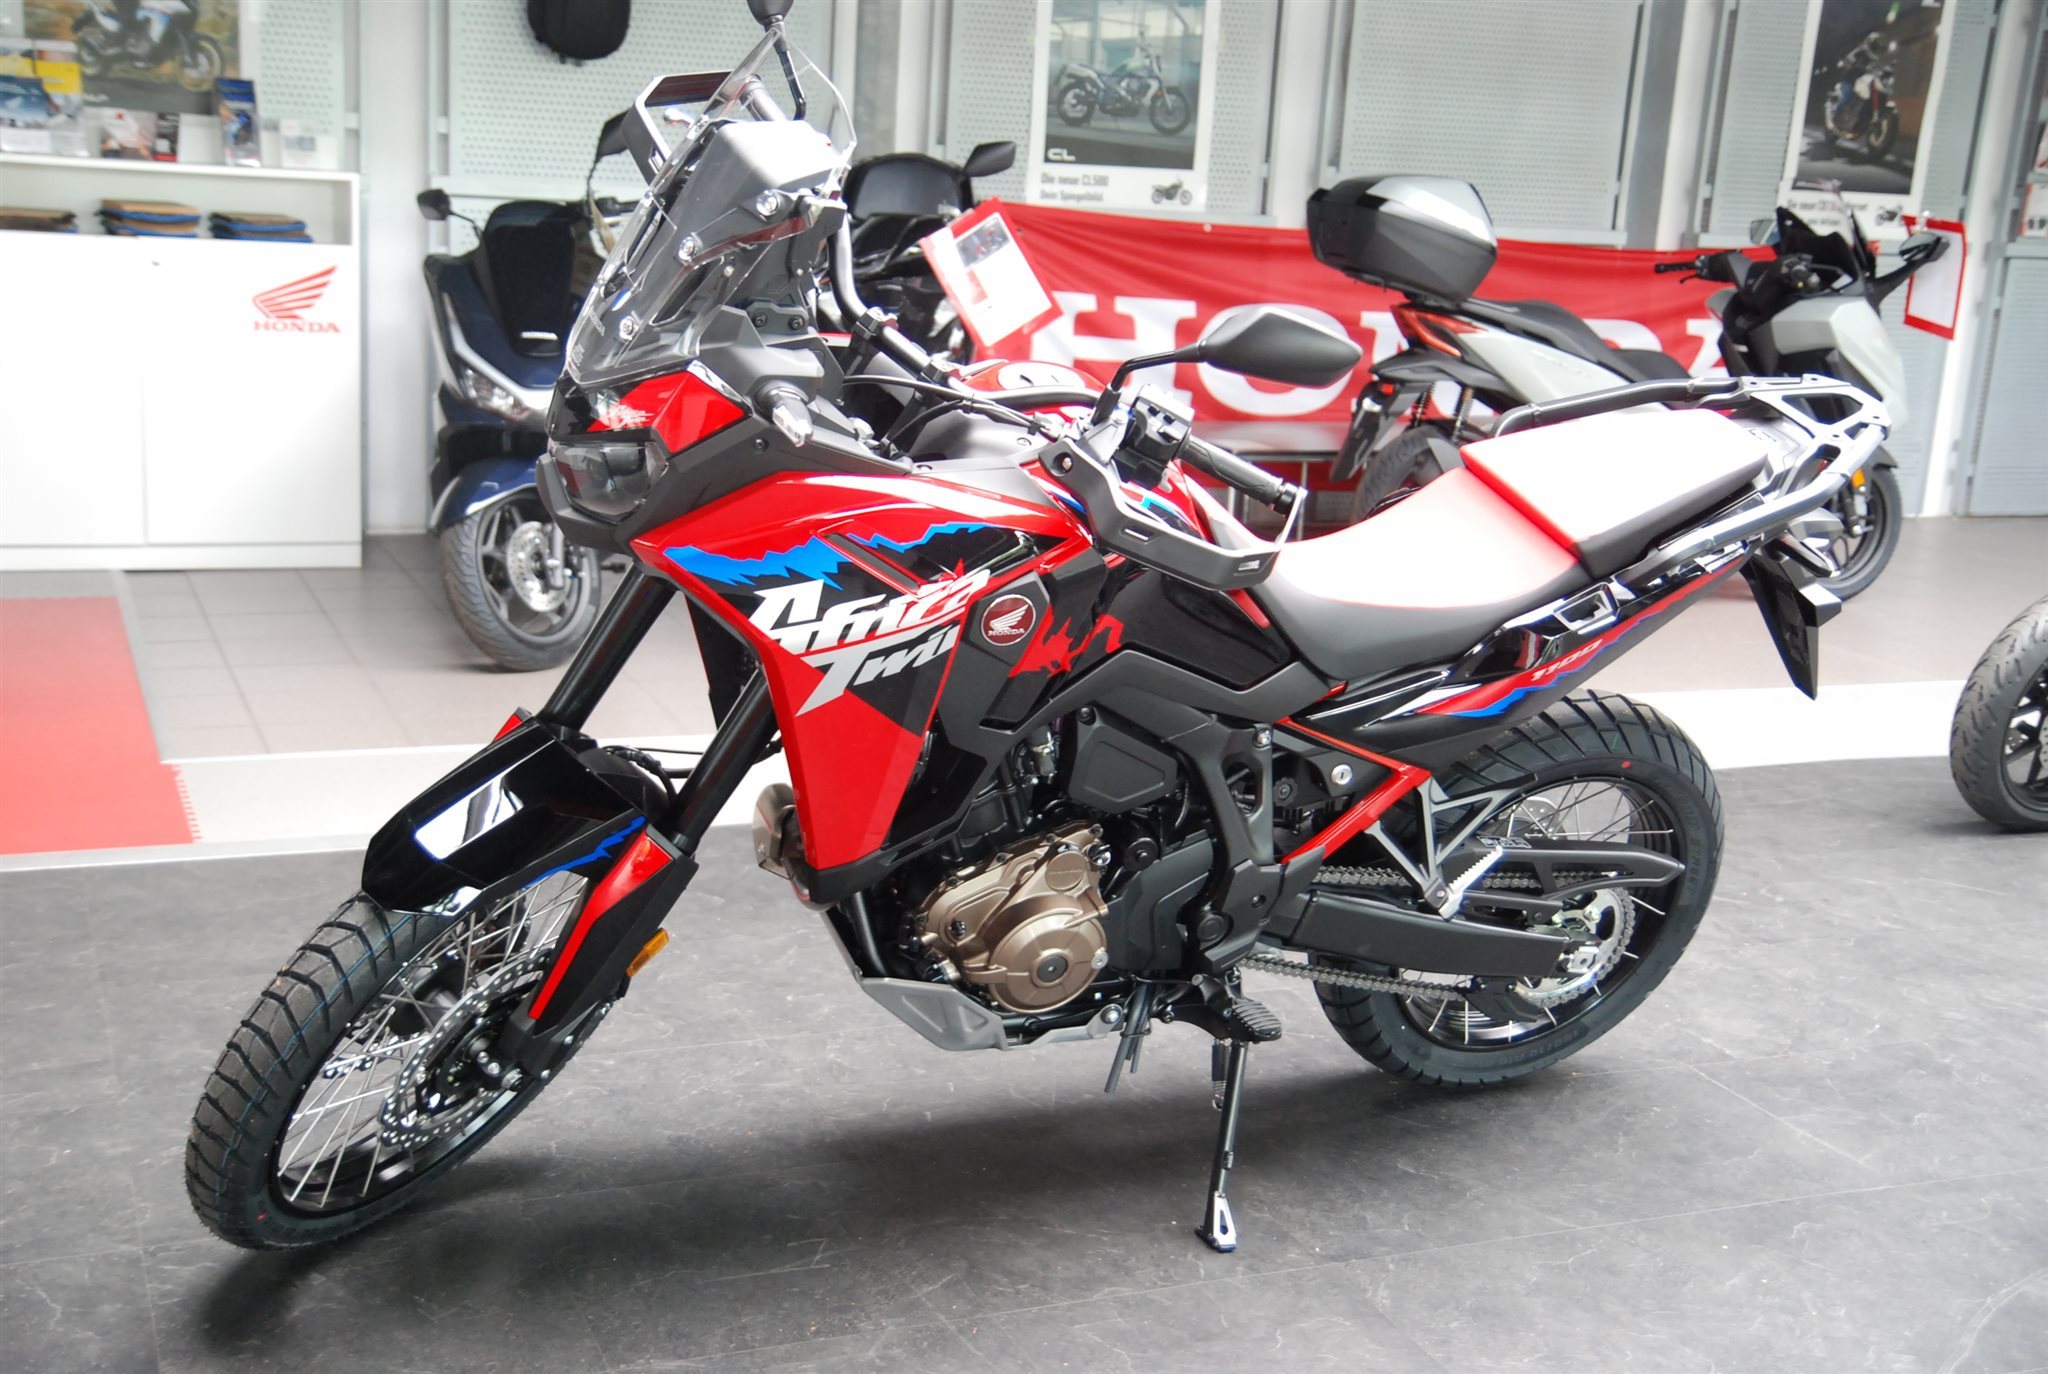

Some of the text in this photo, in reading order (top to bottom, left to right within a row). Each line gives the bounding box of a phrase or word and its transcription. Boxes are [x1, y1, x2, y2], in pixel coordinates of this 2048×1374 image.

[1047, 148, 1076, 162] CL
[253, 321, 341, 334] HONDA
[987, 628, 1026, 637] HONDA
[1531, 638, 1604, 682] 1100
